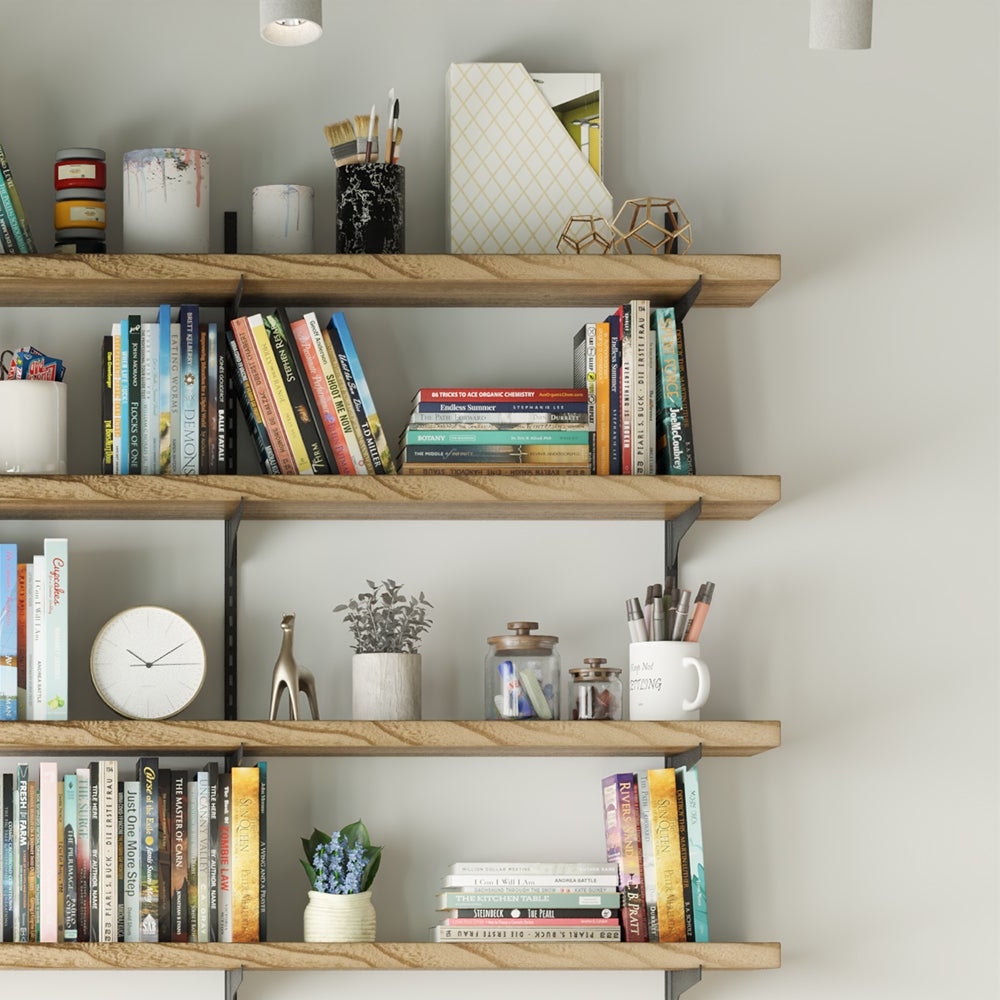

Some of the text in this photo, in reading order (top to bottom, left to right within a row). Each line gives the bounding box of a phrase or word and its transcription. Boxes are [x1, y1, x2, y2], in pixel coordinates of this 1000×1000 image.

[278, 348, 295, 382] STEPHEN
[325, 373, 340, 399] SHOOT
[130, 402, 138, 432] FLOCKS
[334, 400, 345, 413] ME
[339, 415, 352, 434] NOW
[131, 435, 138, 446] OF
[181, 409, 196, 474] DEMONS
[669, 407, 682, 469] JoeMcCoubrey
[131, 448, 139, 467] ONE
[366, 437, 381, 467] MILLER
[49, 557, 64, 605] Cupcakes
[143, 766, 155, 794] Curse
[78, 778, 88, 838] THE SURGE
[146, 817, 154, 834] Exile
[175, 830, 181, 842] OF
[199, 779, 208, 873] UNCANNY VALLEY
[125, 790, 136, 896] Just One More Step
[210, 849, 216, 859] BY
[219, 825, 228, 864] ZOMBIE
[220, 868, 228, 891] LAW
[473, 909, 503, 917] STEINBECK
[528, 909, 554, 917] THE PEARL
[629, 904, 640, 935] PRATT
[511, 930, 524, 938] DIE
[535, 930, 556, 938] BUCK
[569, 930, 594, 938] PEARL
